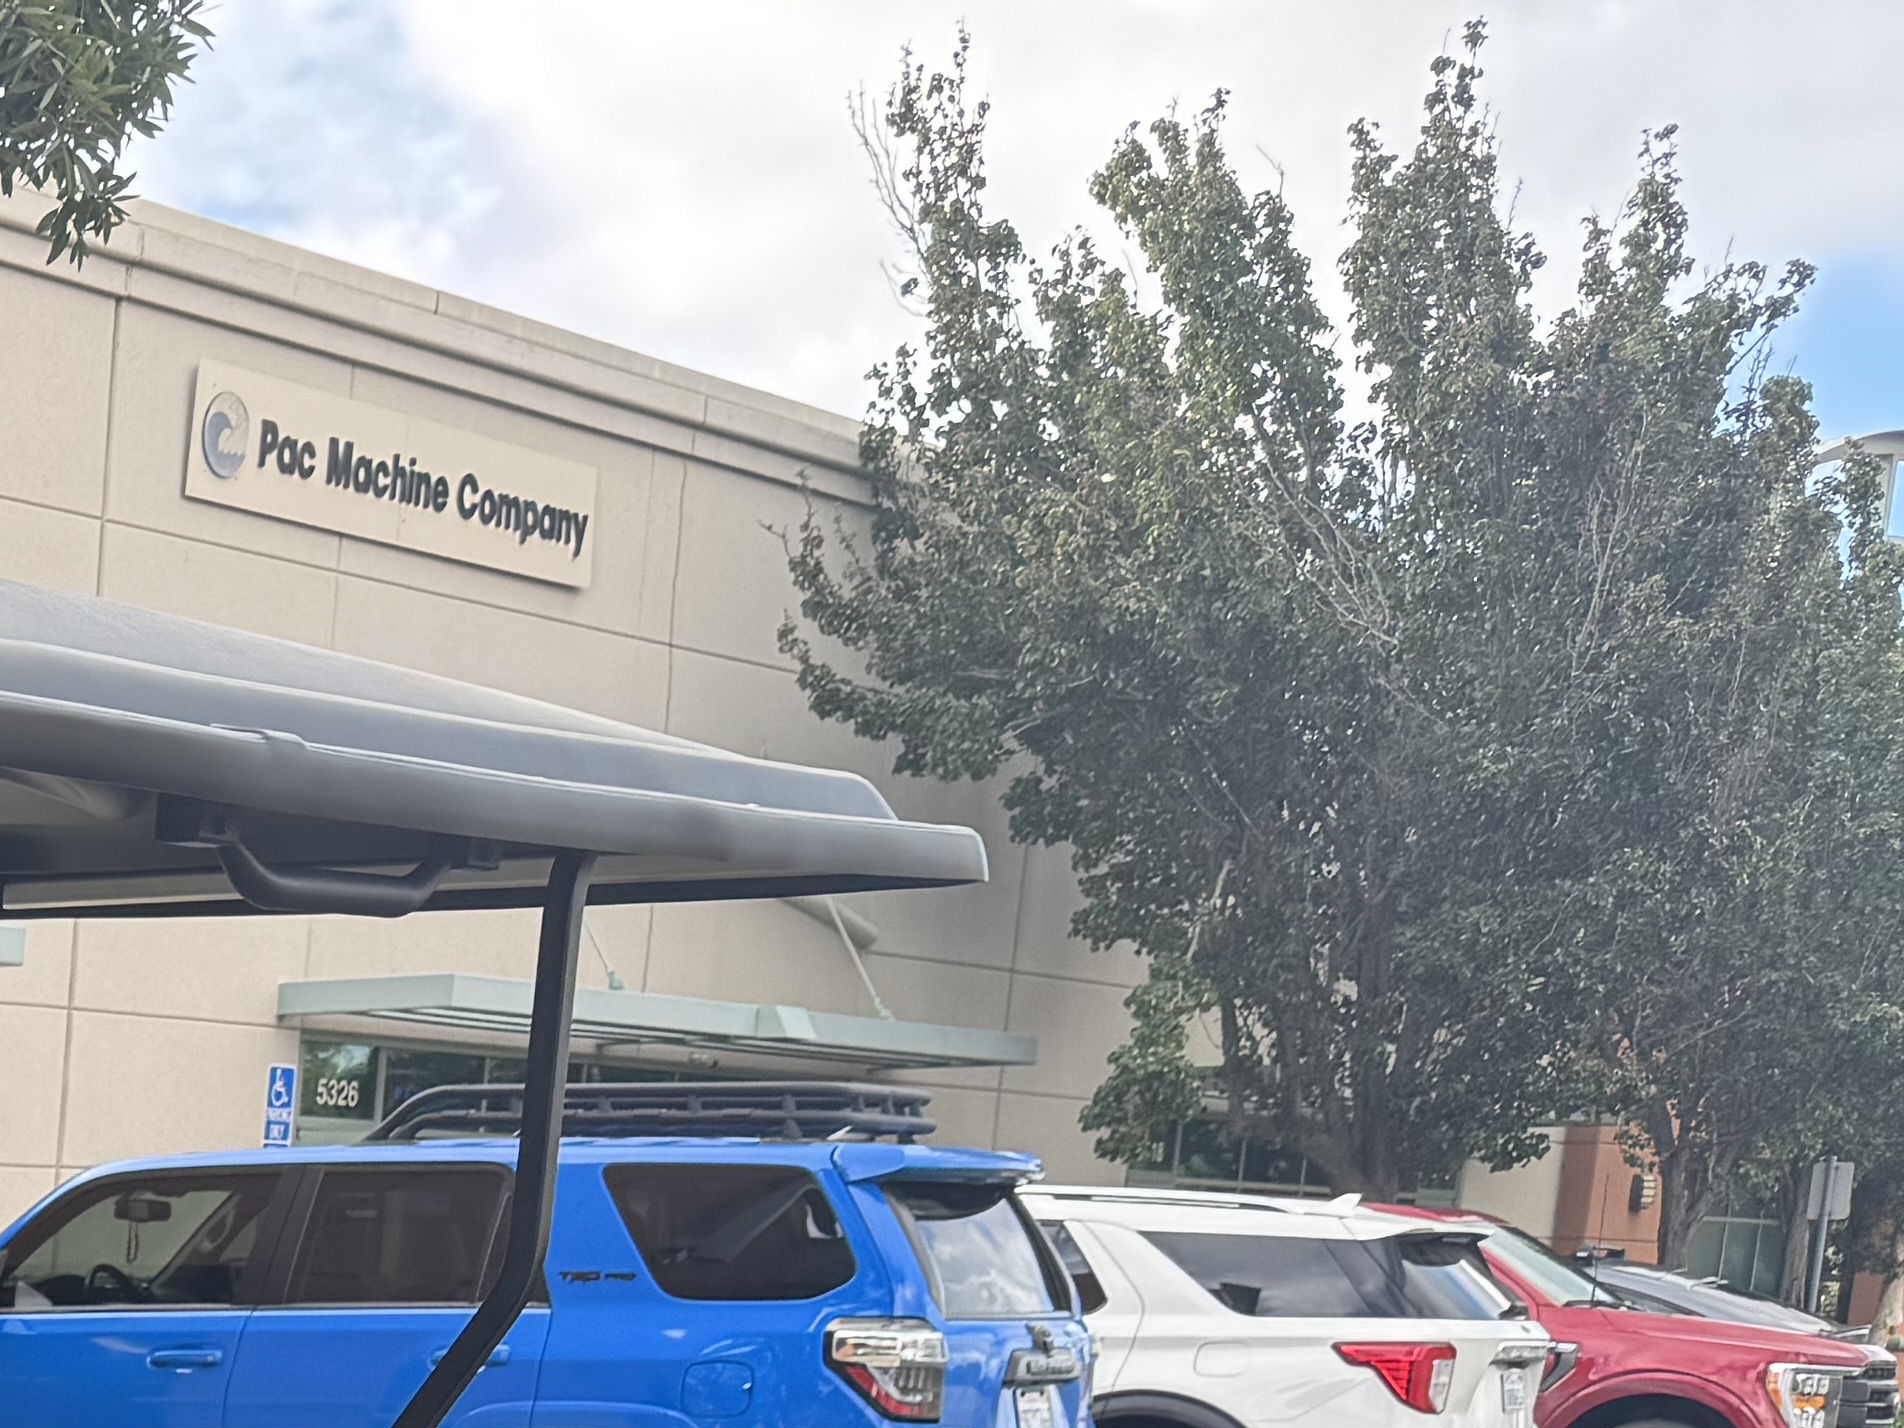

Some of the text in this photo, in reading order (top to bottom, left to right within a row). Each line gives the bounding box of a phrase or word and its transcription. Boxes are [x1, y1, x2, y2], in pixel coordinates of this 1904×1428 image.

[257, 419, 588, 561] Pac Machine Company
[316, 1078, 359, 1107] 5326
